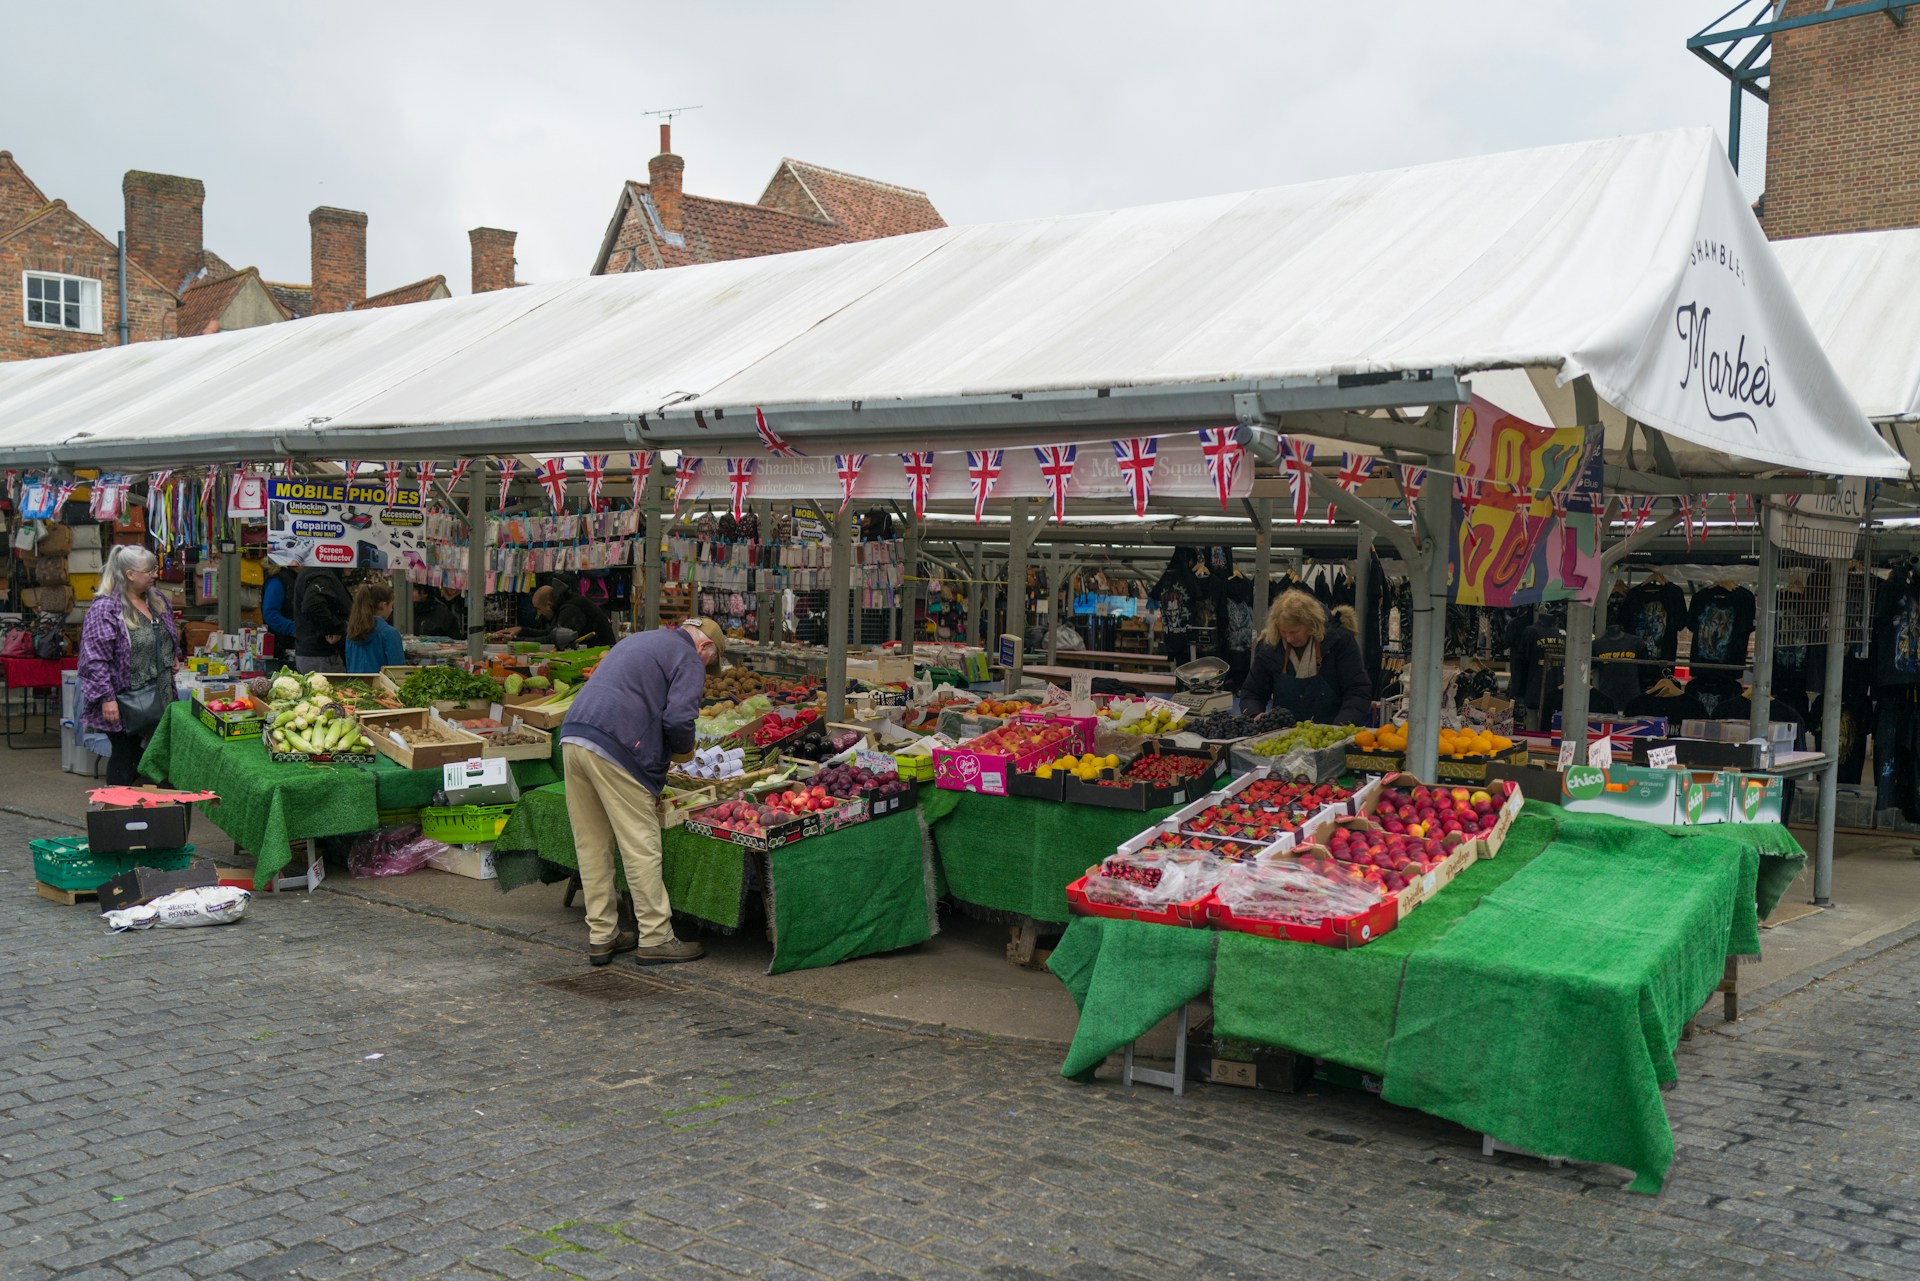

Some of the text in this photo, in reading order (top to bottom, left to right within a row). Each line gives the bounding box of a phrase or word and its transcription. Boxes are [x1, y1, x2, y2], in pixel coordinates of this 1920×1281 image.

[1677, 301, 1776, 434] Market
[756, 457, 815, 476] Shambles
[1584, 478, 1599, 489] Bus
[276, 482, 419, 505] MOBILE PHOES
[289, 501, 327, 513] Unlocking
[381, 509, 423, 520] Accessories
[295, 520, 343, 534] Repairing
[319, 546, 343, 554] Screen
[319, 553, 352, 562] Protector
[960, 758, 975, 770] Pink
[963, 765, 977, 775] Lady
[1567, 773, 1603, 789] chico
[1689, 791, 1702, 813] chico
[1745, 791, 1759, 810] chico
[167, 902, 197, 911] JERSEY
[168, 909, 199, 919] ROYALS
